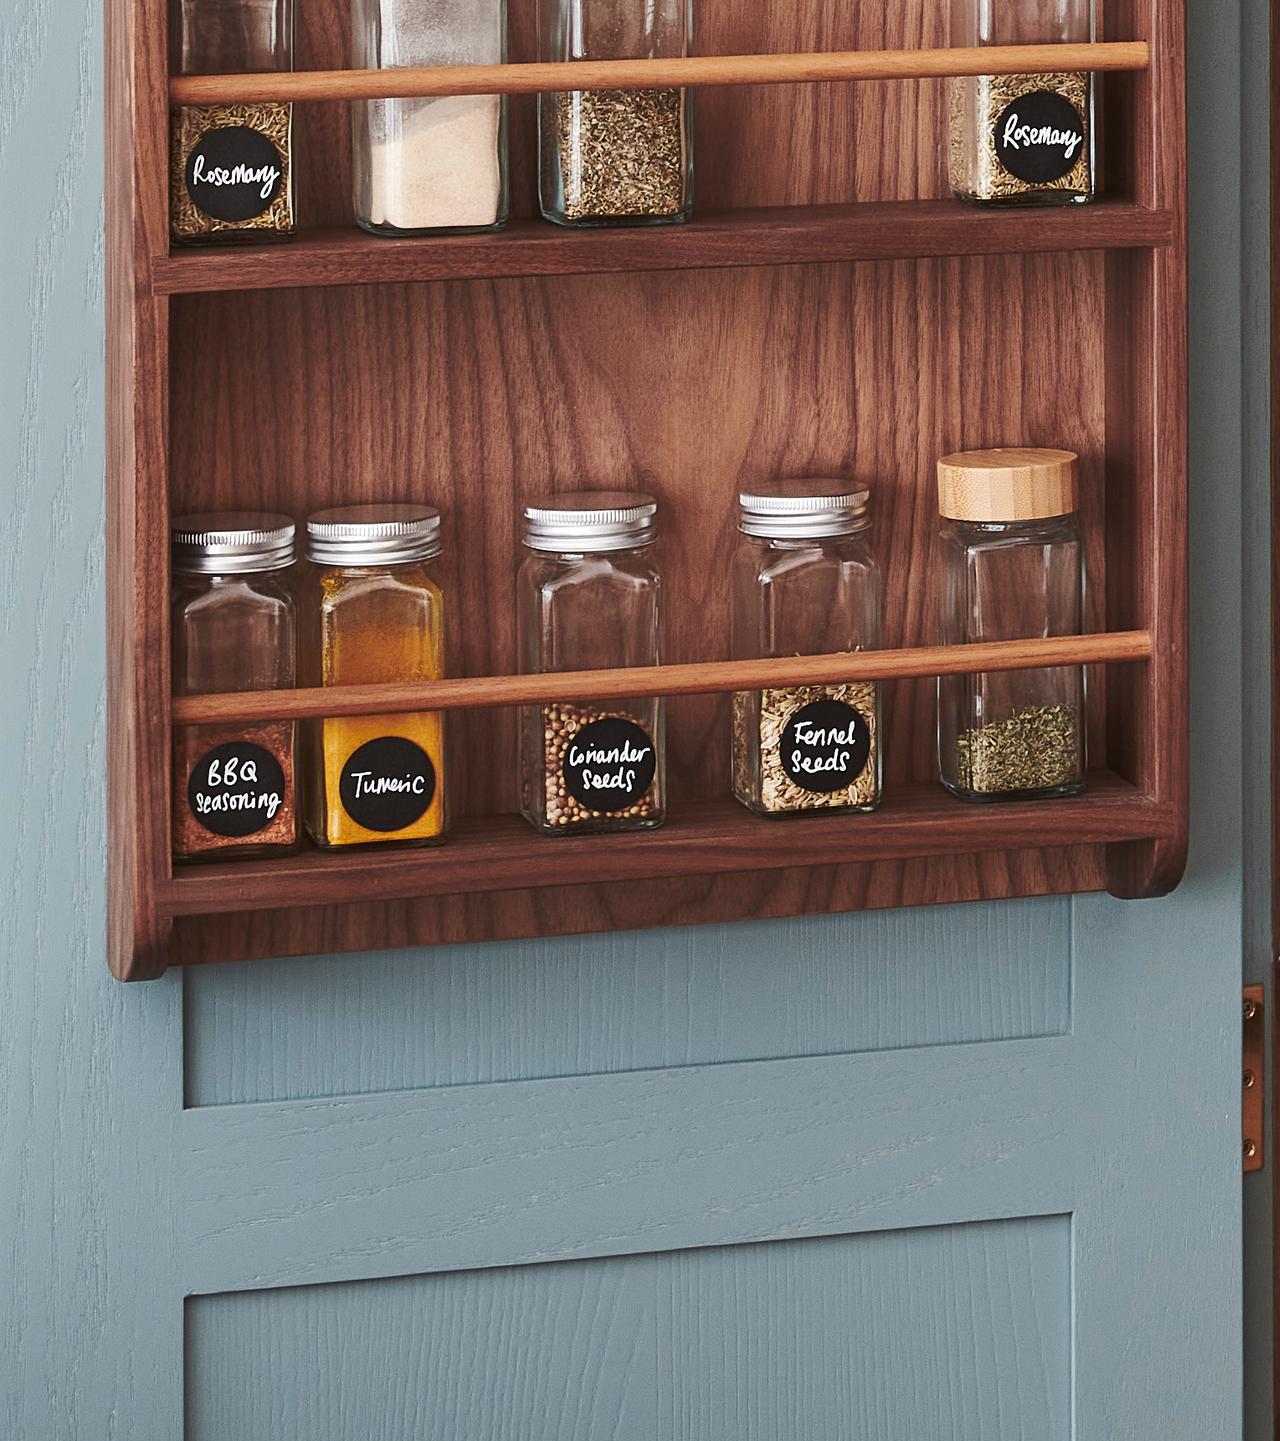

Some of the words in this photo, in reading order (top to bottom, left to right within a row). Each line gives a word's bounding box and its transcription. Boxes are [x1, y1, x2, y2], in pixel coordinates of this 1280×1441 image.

[1002, 113, 1083, 159] Rosemary
[192, 154, 280, 200] Rosemary
[793, 720, 856, 747] Fennel
[569, 739, 651, 767] Coriander
[207, 756, 258, 787] BBQ
[350, 771, 425, 799] Tumeric
